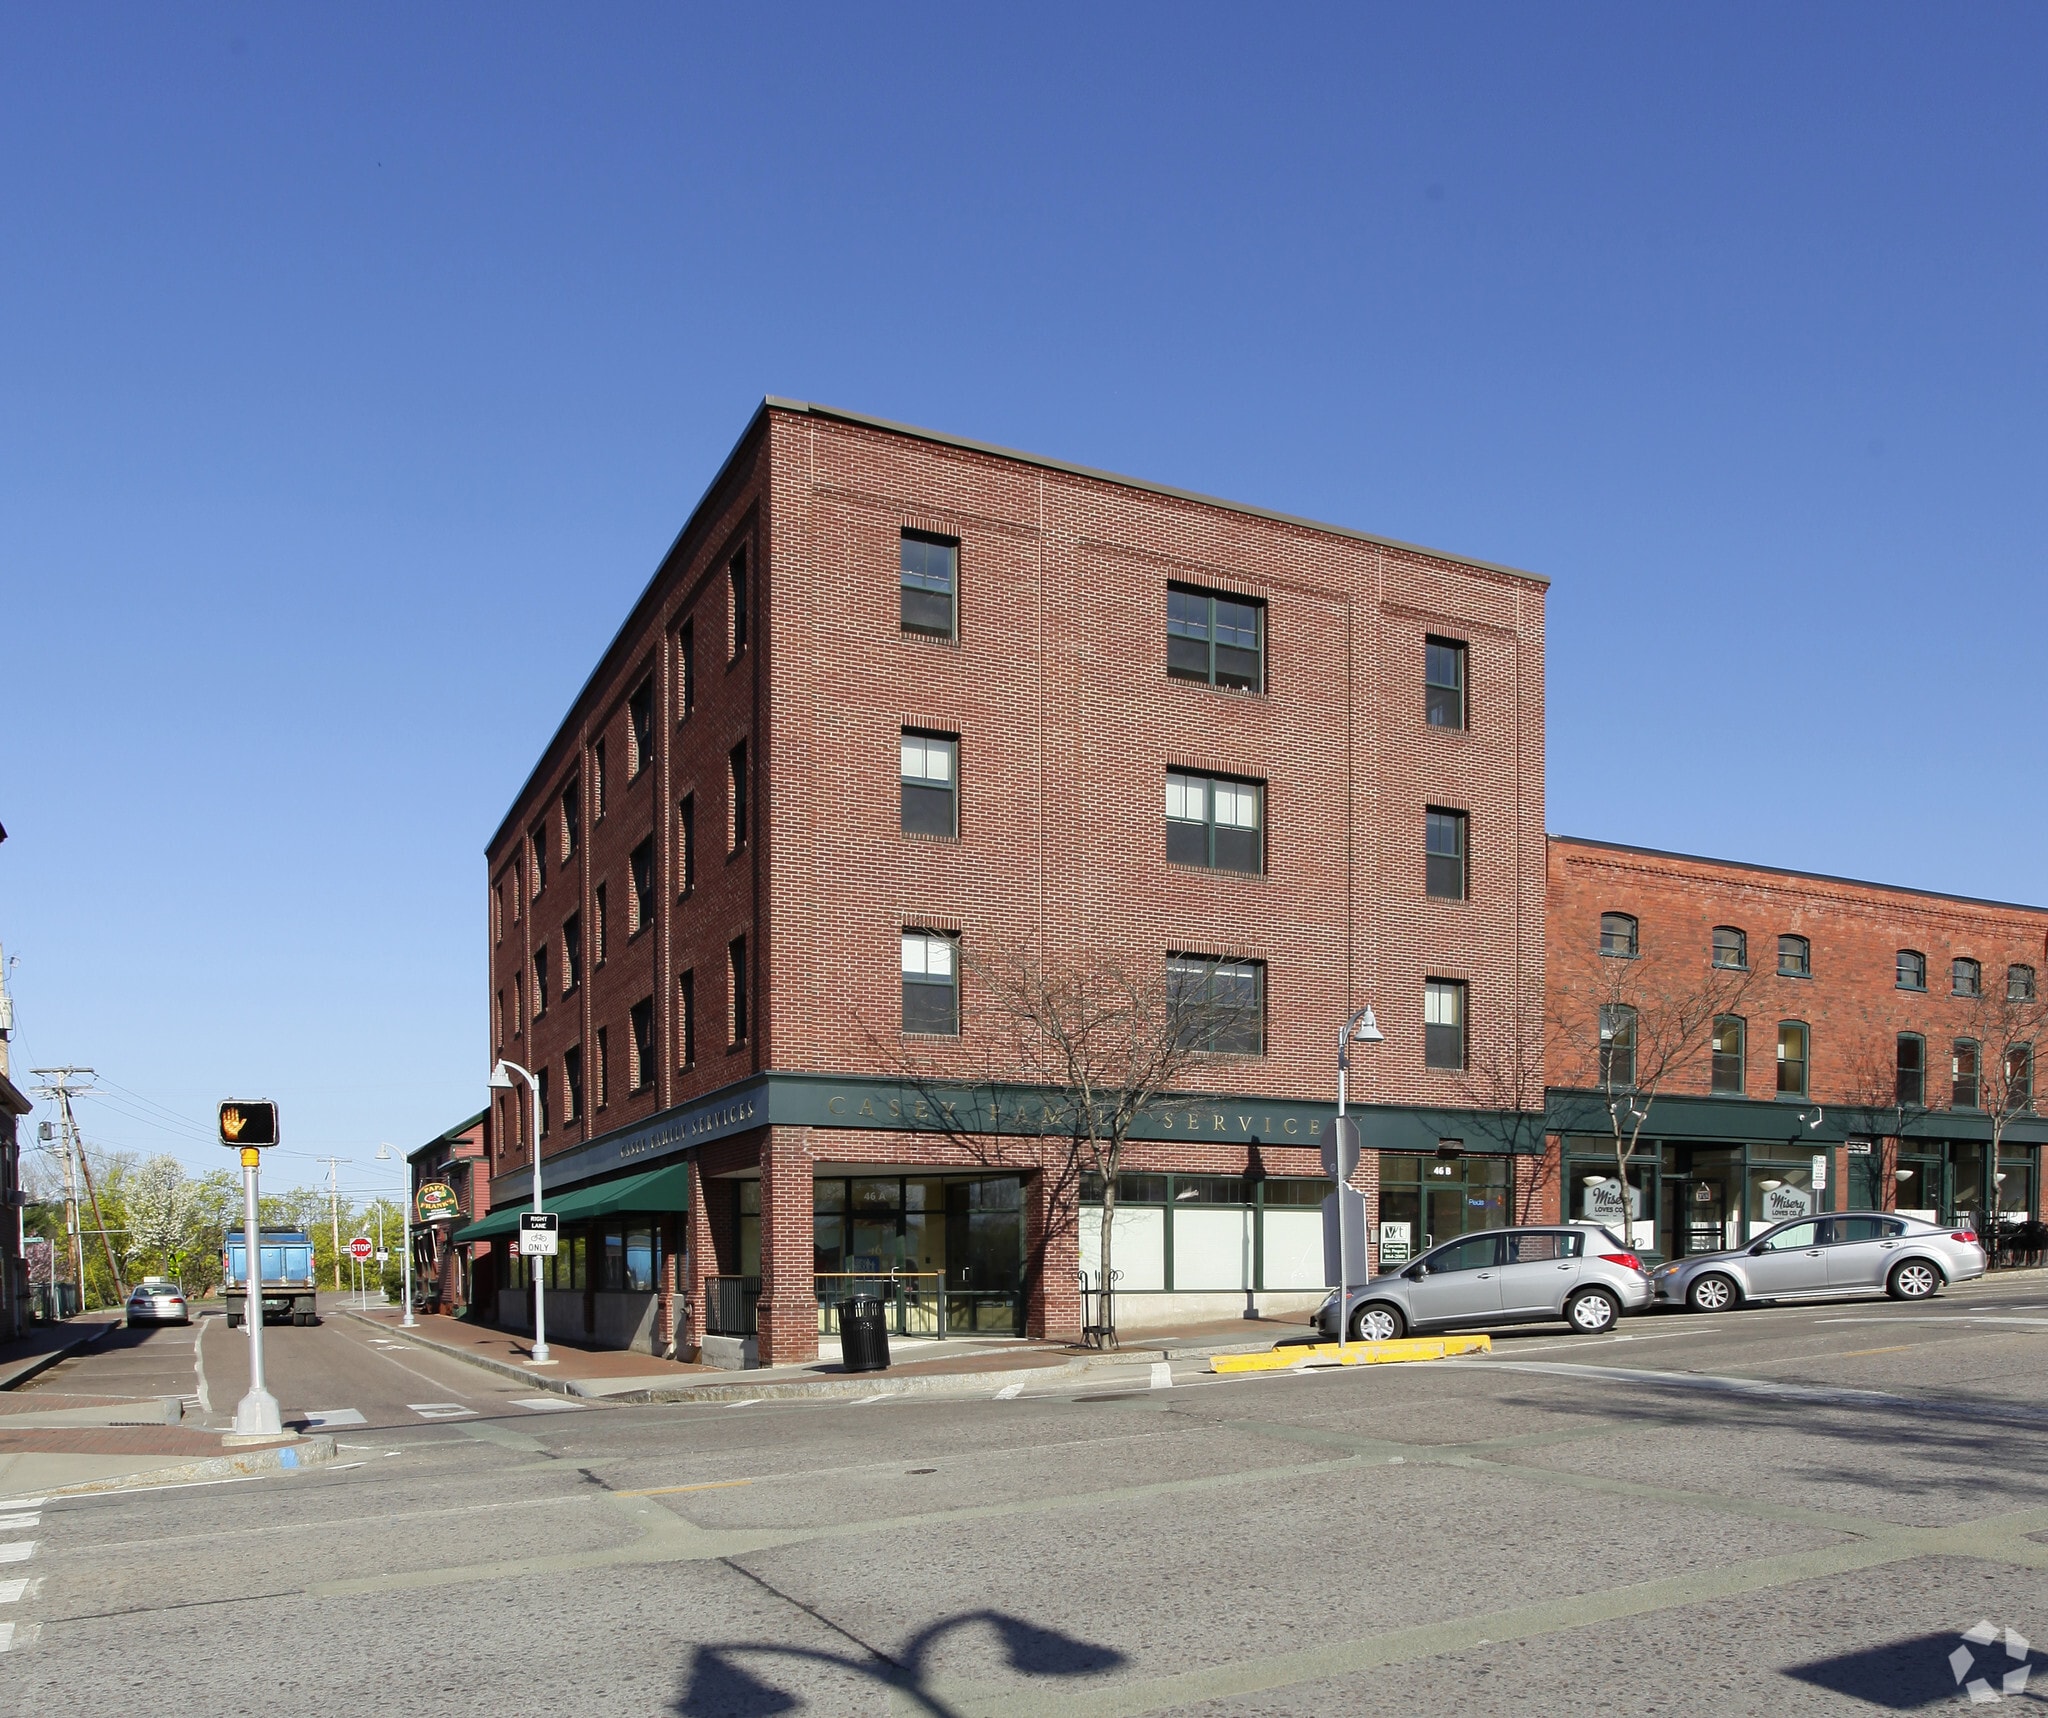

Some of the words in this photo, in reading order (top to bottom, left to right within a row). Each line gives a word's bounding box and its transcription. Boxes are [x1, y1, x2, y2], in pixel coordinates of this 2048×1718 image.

[829, 1096, 956, 1120] CASEY
[1163, 1111, 1320, 1135] SERVICE
[620, 1136, 646, 1159] CASEY
[651, 1124, 687, 1149] FAMILY
[692, 1100, 754, 1136] SERVICES
[1433, 1166, 1444, 1175] 46
[1445, 1167, 1451, 1175] B
[864, 1192, 876, 1200] 46
[879, 1192, 886, 1200] A
[1593, 1188, 1634, 1207] Mise
[1771, 1192, 1805, 1217] Misery
[351, 1244, 370, 1252] STOP
[528, 1243, 549, 1252] ONLY
